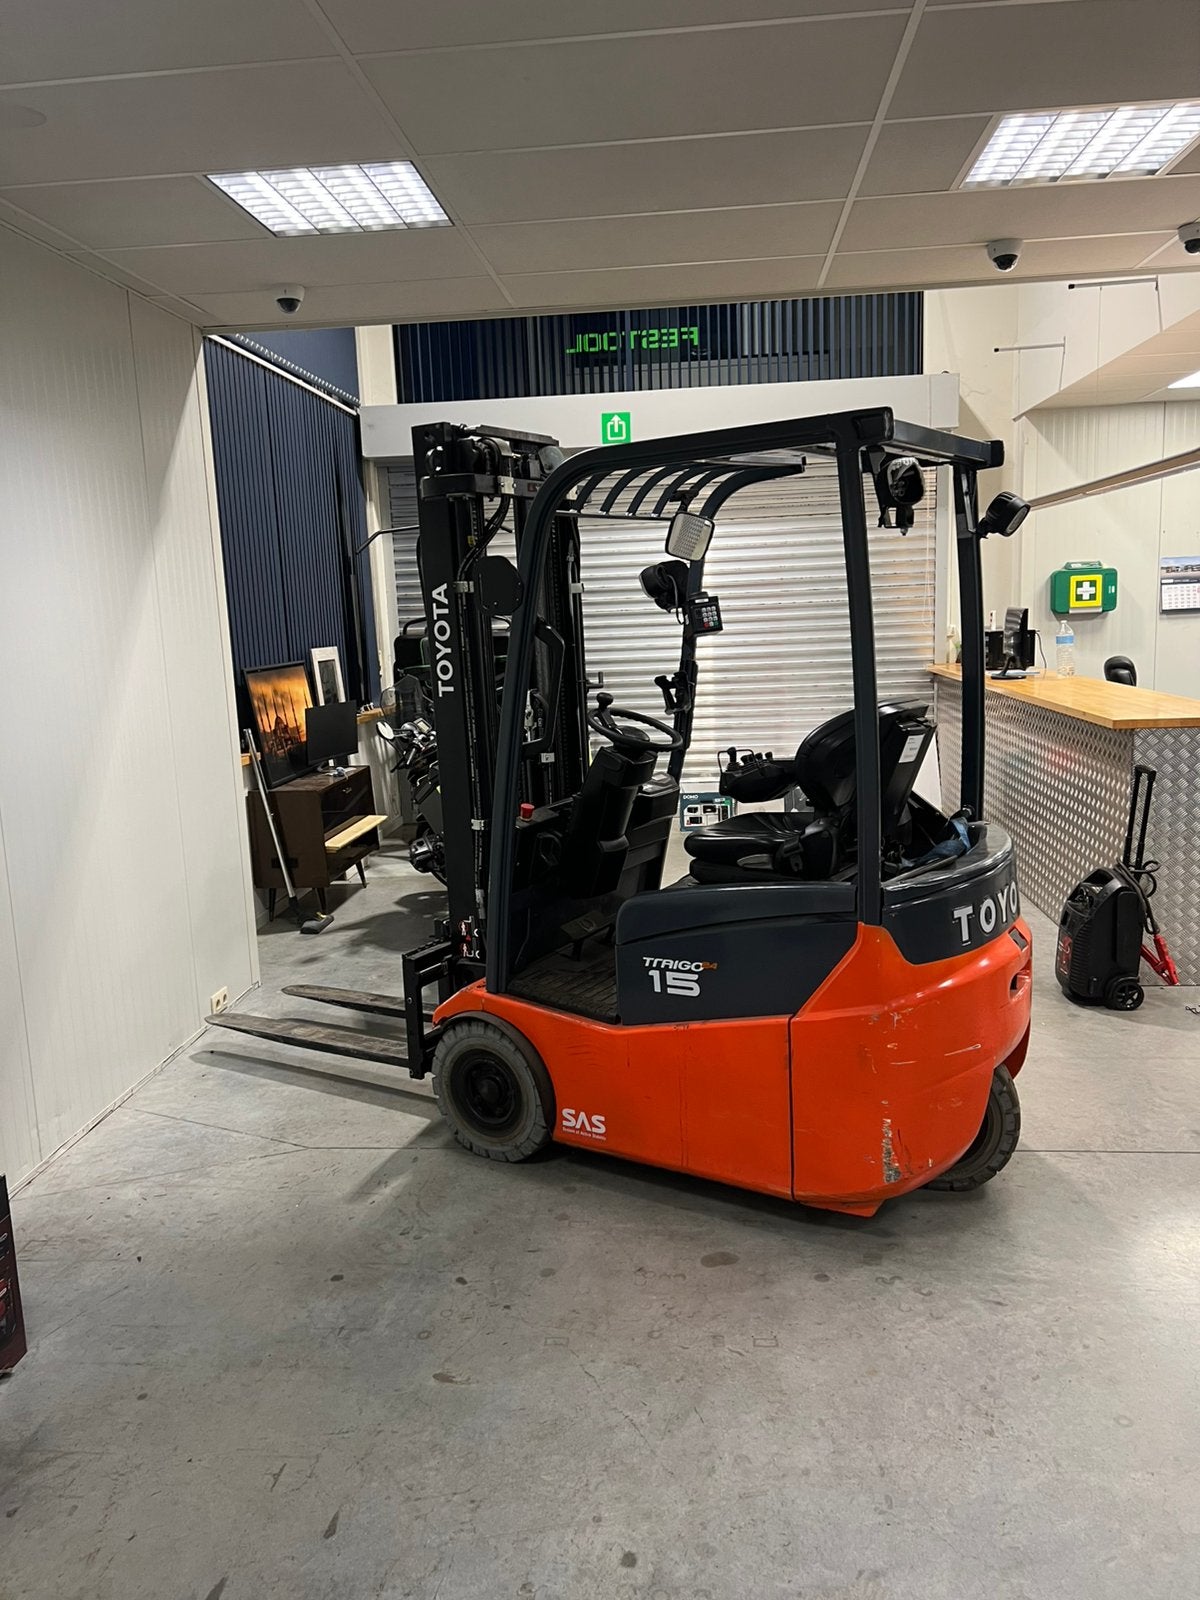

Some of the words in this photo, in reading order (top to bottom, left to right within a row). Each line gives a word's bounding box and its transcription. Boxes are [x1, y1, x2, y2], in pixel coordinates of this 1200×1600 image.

[431, 582, 455, 698] TOYOTA
[648, 969, 701, 997] 15
[561, 1108, 606, 1134] SAS
